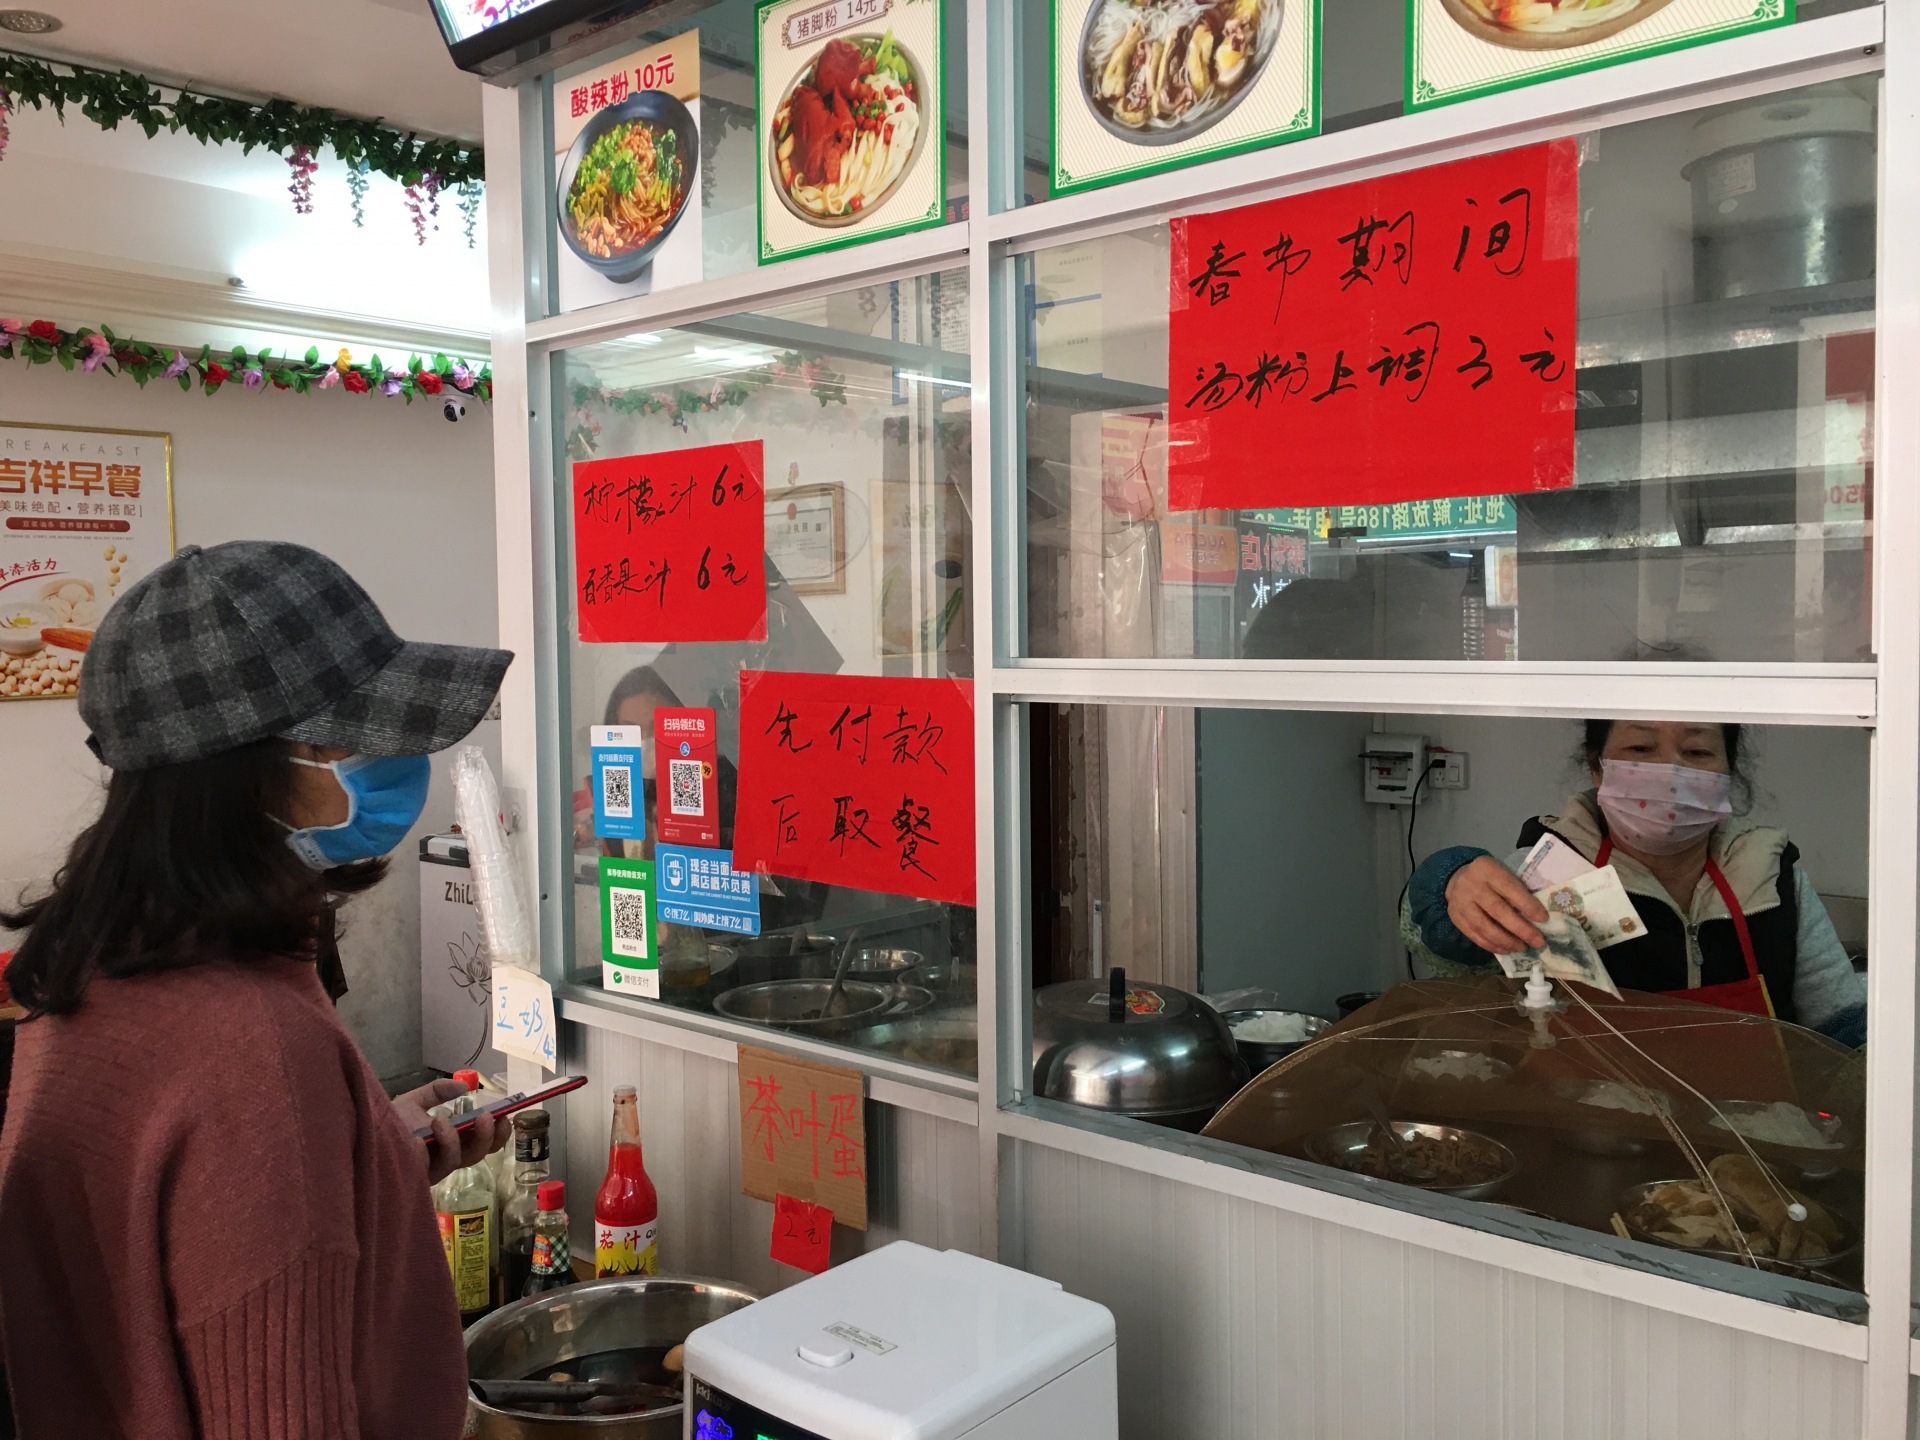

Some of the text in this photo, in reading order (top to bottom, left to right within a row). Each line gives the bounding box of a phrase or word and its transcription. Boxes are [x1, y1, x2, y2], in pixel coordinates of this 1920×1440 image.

[797, 5, 838, 39] 猪脚粉
[570, 53, 675, 118] 酸辣粉 10元
[1188, 188, 1531, 325] 春节期间
[0, 458, 141, 498] 吉祥早餐
[583, 463, 759, 535] 柠檬汁 6元
[697, 545, 749, 590] 6元
[663, 718, 706, 732] 扫码领红包
[765, 701, 948, 776] 先付款
[770, 793, 940, 882] 后取餐
[606, 868, 648, 881] 推荐使用微信支付
[623, 974, 649, 988] 微信支付
[744, 1075, 866, 1185] 茶叶蛋
[599, 1229, 642, 1251] 茄汁
[783, 1214, 822, 1245] 2元
